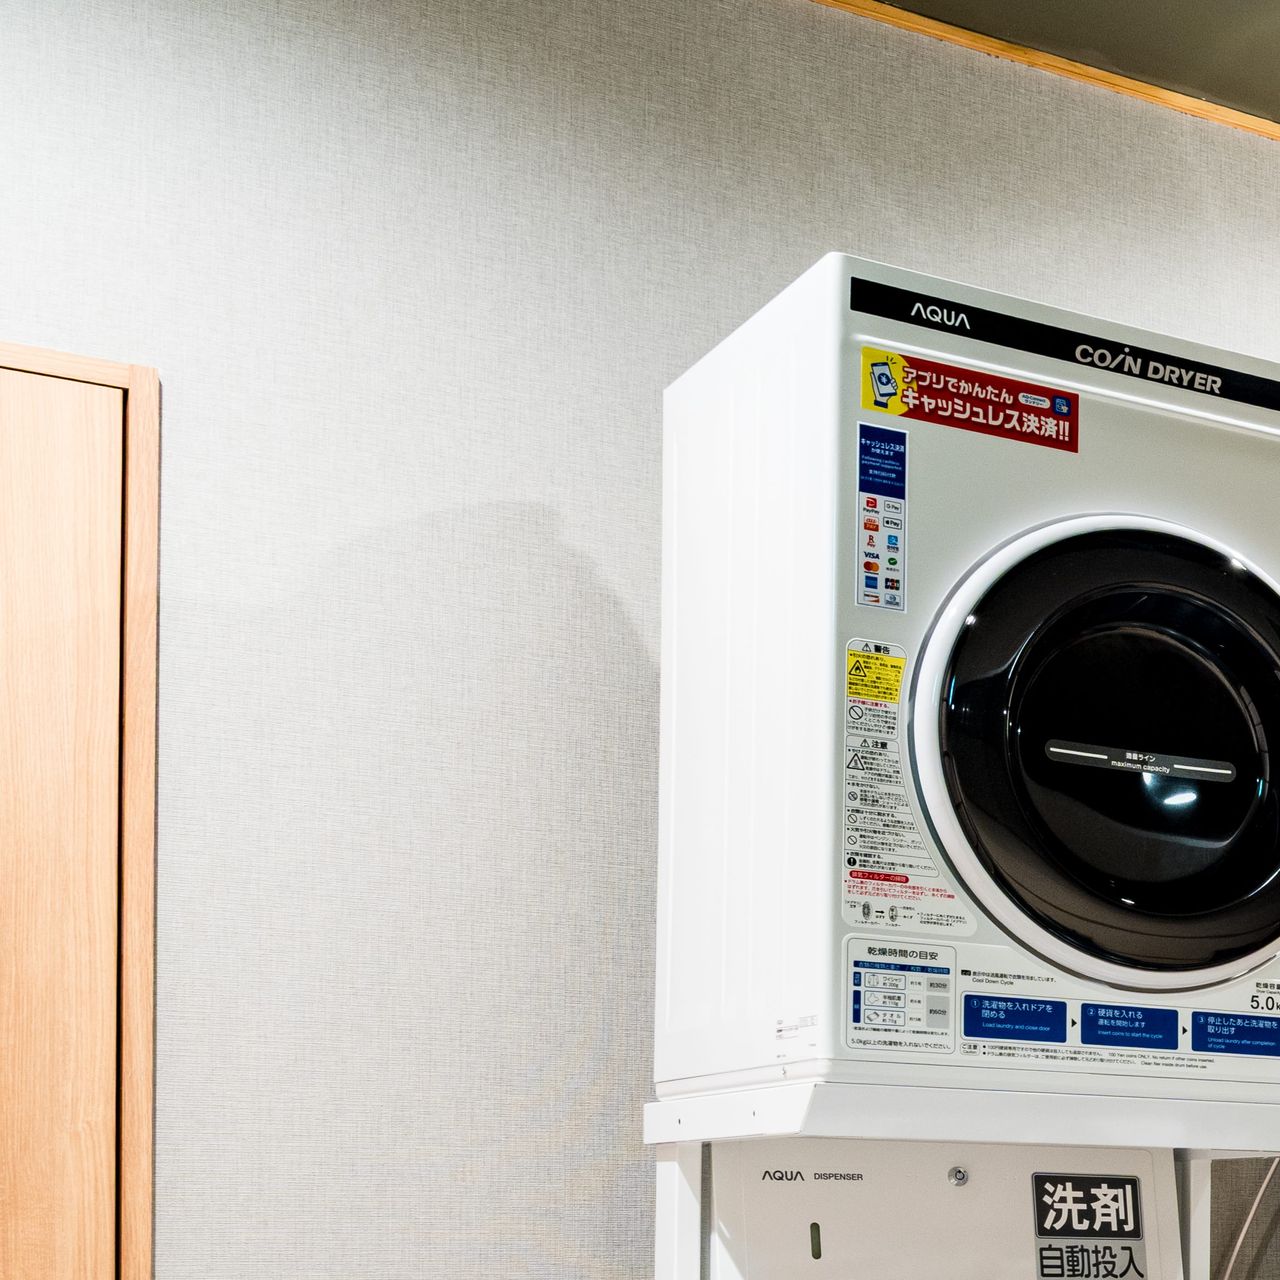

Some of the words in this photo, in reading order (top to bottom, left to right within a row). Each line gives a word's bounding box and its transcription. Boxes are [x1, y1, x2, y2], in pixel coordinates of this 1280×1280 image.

[911, 302, 971, 330] AQUA
[1147, 361, 1223, 395] DRYER
[903, 367, 1013, 404] アプリでかんたん
[864, 551, 880, 559] VISA
[872, 740, 888, 749] 注意
[1111, 761, 1142, 769] maximum
[1143, 765, 1170, 774] capacity
[868, 947, 938, 960] 乾燥時間の目安
[982, 1000, 1053, 1013] 洗濯物を入れドアを
[1098, 1009, 1142, 1019] 硬貨を入れる
[1207, 1016, 1278, 1029] 停止したあと洗濯物を
[1207, 1026, 1235, 1034] 取り出す
[762, 1170, 804, 1181] AQUA
[814, 1172, 863, 1181] DISPENSER
[1042, 1183, 1135, 1232] 洗剤
[1039, 1245, 1145, 1279] 自動投入
